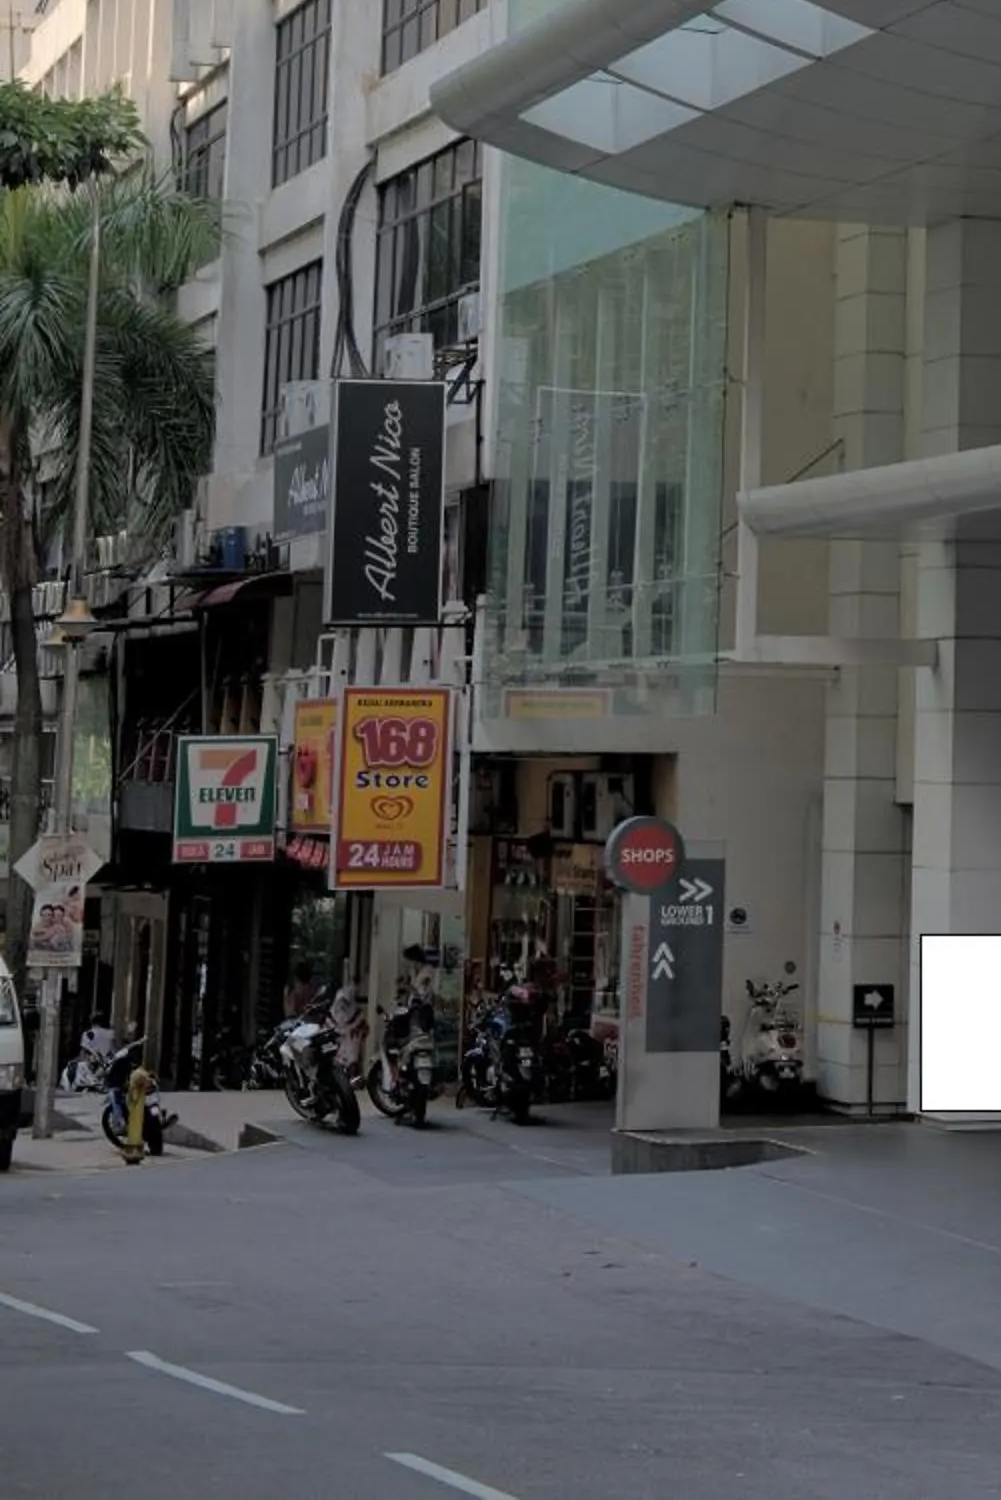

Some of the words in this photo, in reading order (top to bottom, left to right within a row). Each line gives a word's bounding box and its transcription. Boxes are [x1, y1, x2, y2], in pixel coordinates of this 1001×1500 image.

[369, 399, 402, 481] Nico
[408, 447, 421, 489] SALON
[364, 481, 399, 602] Albert
[407, 491, 419, 554] BOUTIQUE
[355, 716, 437, 767] 168
[200, 749, 257, 827] 7
[356, 771, 430, 789] Store
[214, 843, 235, 859] 24
[348, 843, 381, 868] 24
[383, 843, 415, 856] JAM
[621, 849, 675, 864] SHOPS
[661, 905, 703, 917] LOWER
